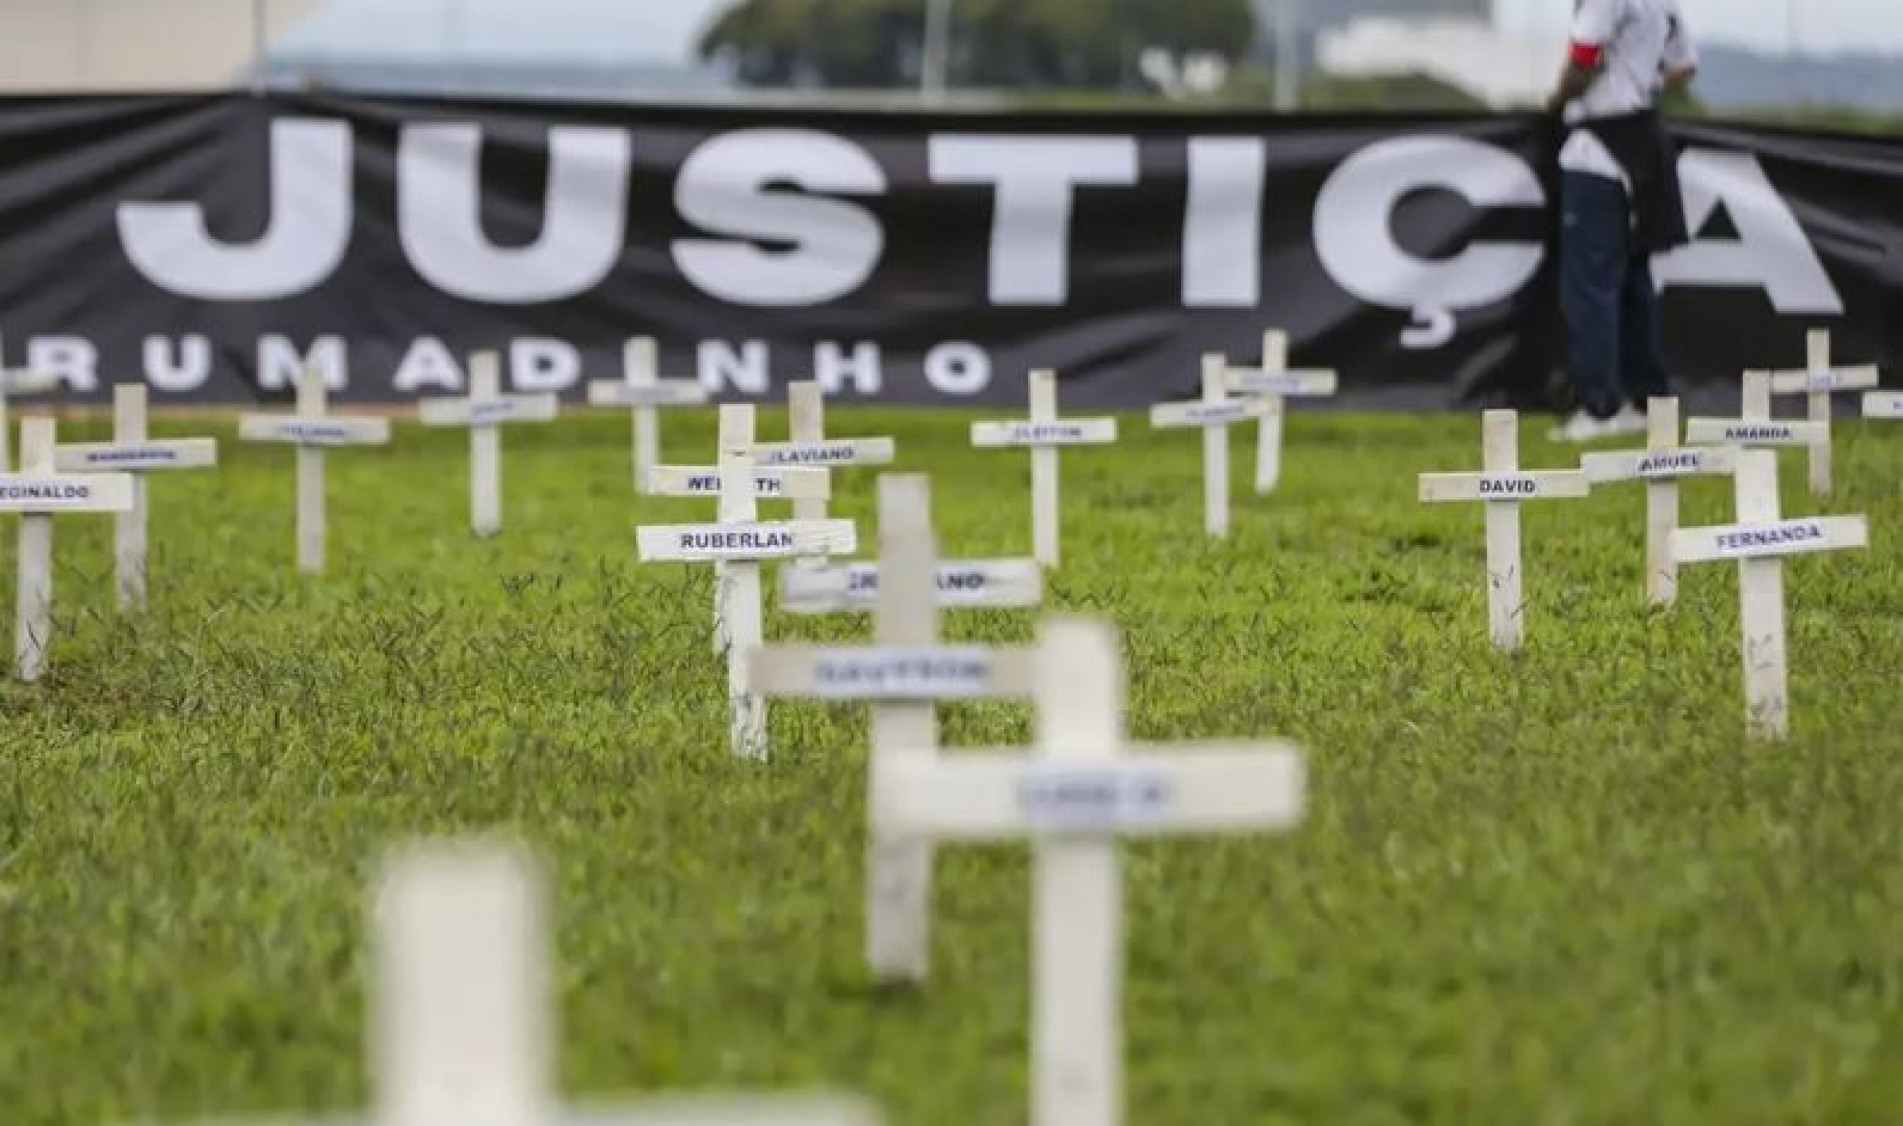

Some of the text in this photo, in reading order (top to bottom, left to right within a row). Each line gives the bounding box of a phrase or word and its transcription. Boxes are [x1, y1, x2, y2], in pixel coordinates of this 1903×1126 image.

[116, 117, 1844, 348] JUSTIÇA
[27, 333, 992, 394] RUMADNHO
[1724, 426, 1792, 440] AMANDA
[687, 476, 781, 492] WETH
[1479, 478, 1536, 493] DAVID
[1716, 523, 1822, 549] FERNANDA
